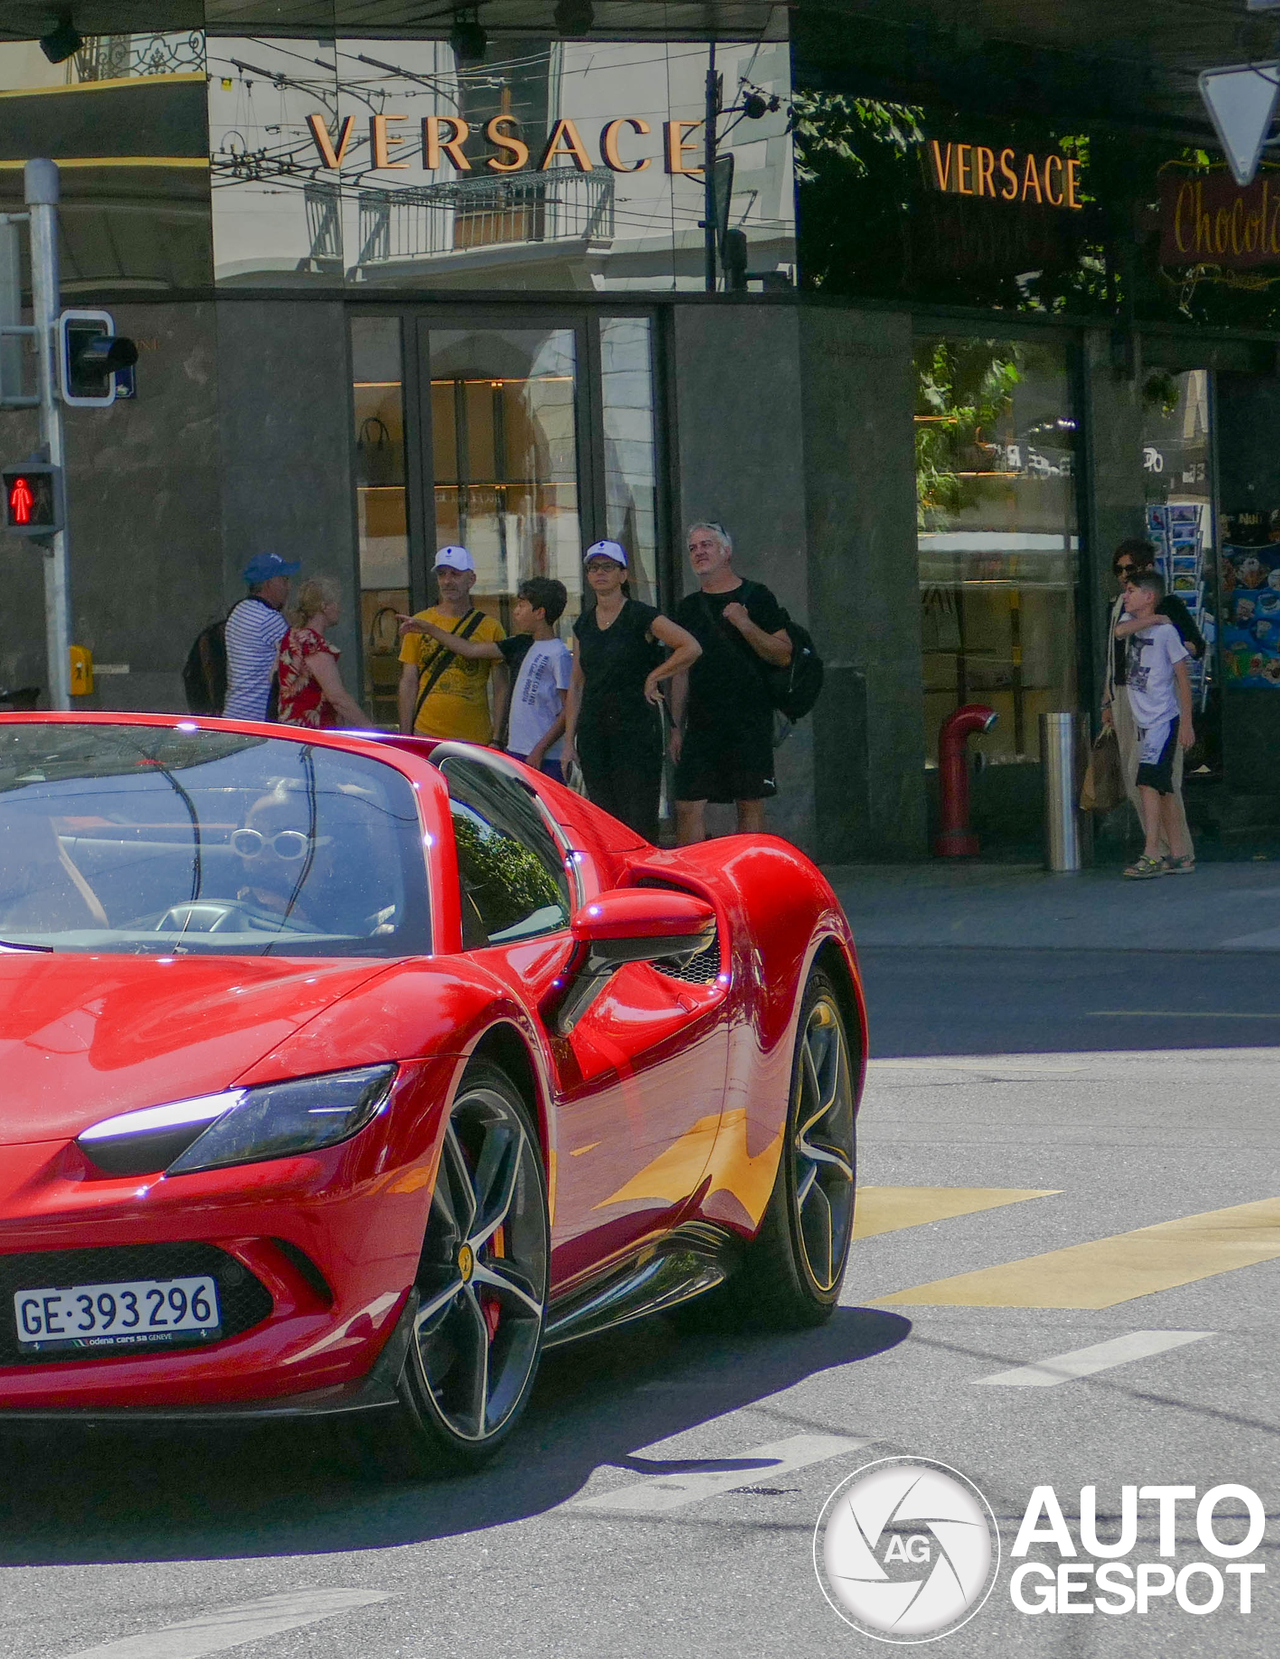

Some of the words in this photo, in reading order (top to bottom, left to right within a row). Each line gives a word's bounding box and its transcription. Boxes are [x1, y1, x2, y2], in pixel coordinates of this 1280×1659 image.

[304, 113, 707, 174] VERSACE
[932, 139, 1083, 209] VERSACE
[116, 1335, 135, 1344] cars
[136, 1334, 148, 1342] sa
